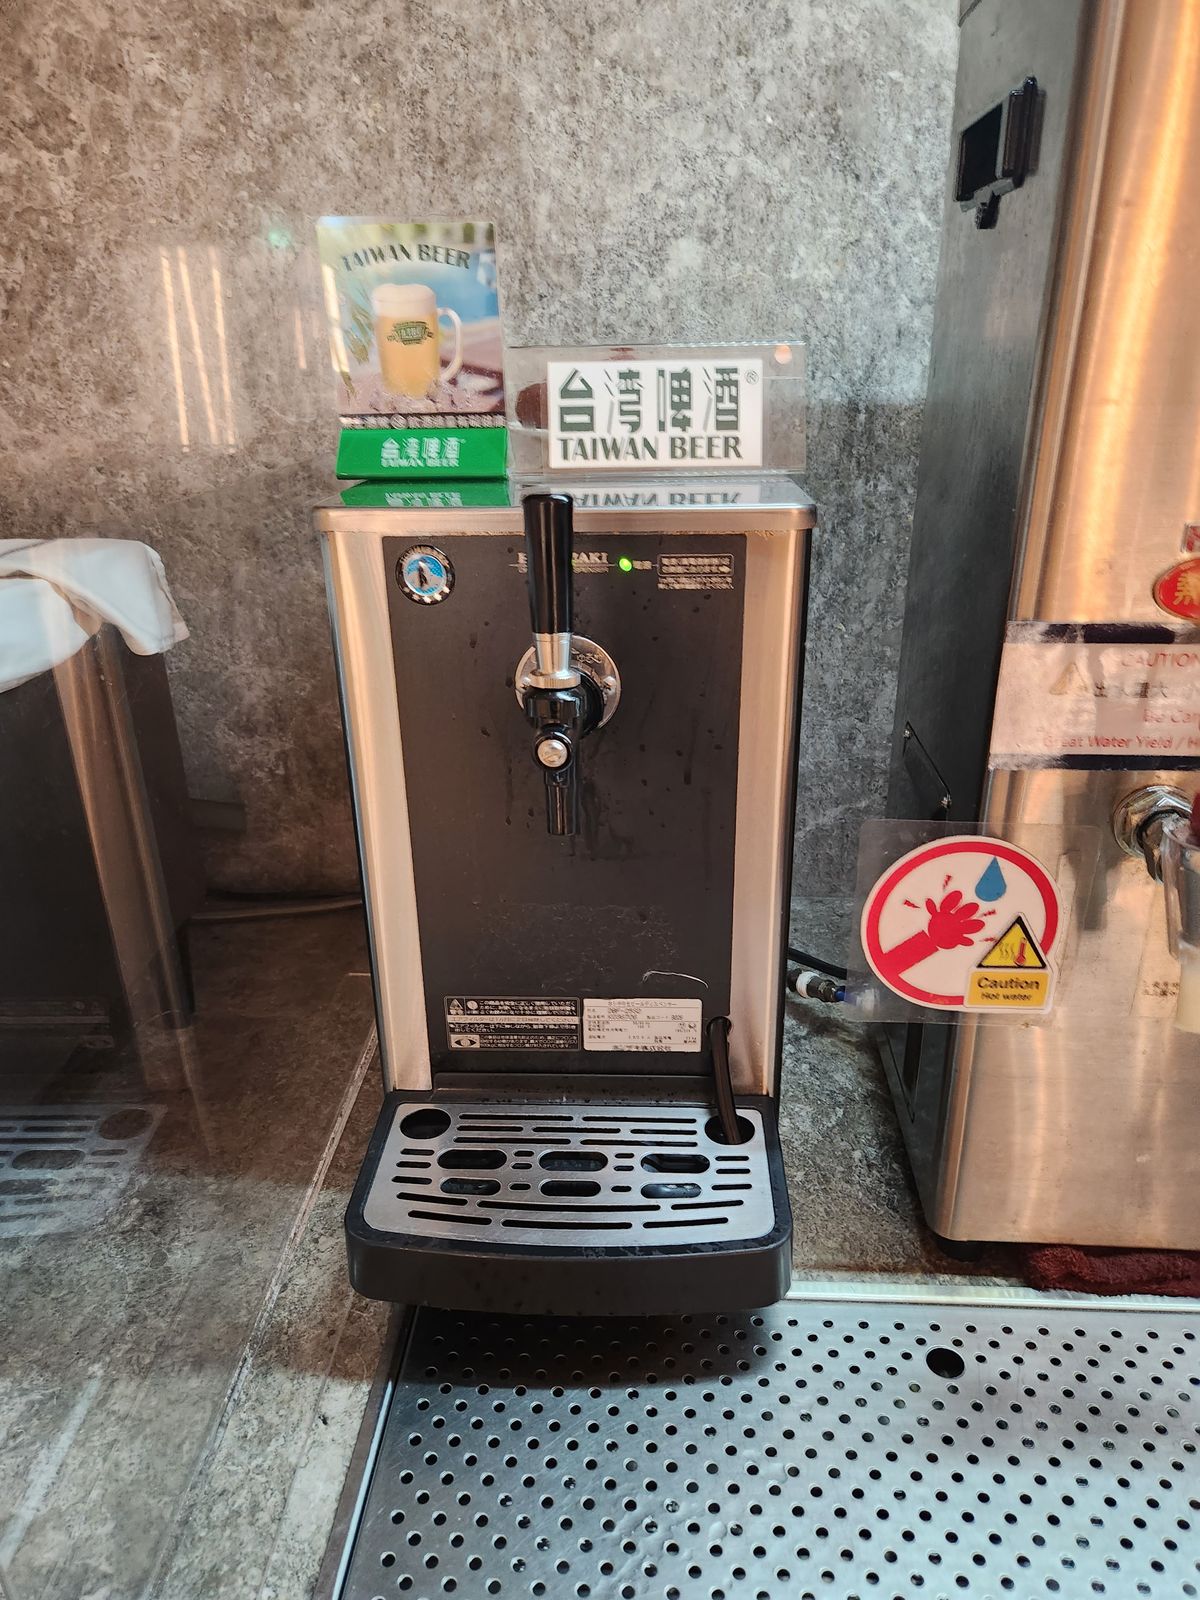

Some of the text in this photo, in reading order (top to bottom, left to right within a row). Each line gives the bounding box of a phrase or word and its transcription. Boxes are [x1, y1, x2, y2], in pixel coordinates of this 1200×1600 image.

[342, 243, 470, 271] TAIWAN BEER
[557, 435, 743, 460] TAIWAN BEER
[1089, 735, 1133, 748] Water
[1136, 735, 1173, 749] Yield
[977, 975, 1040, 990] Caution
